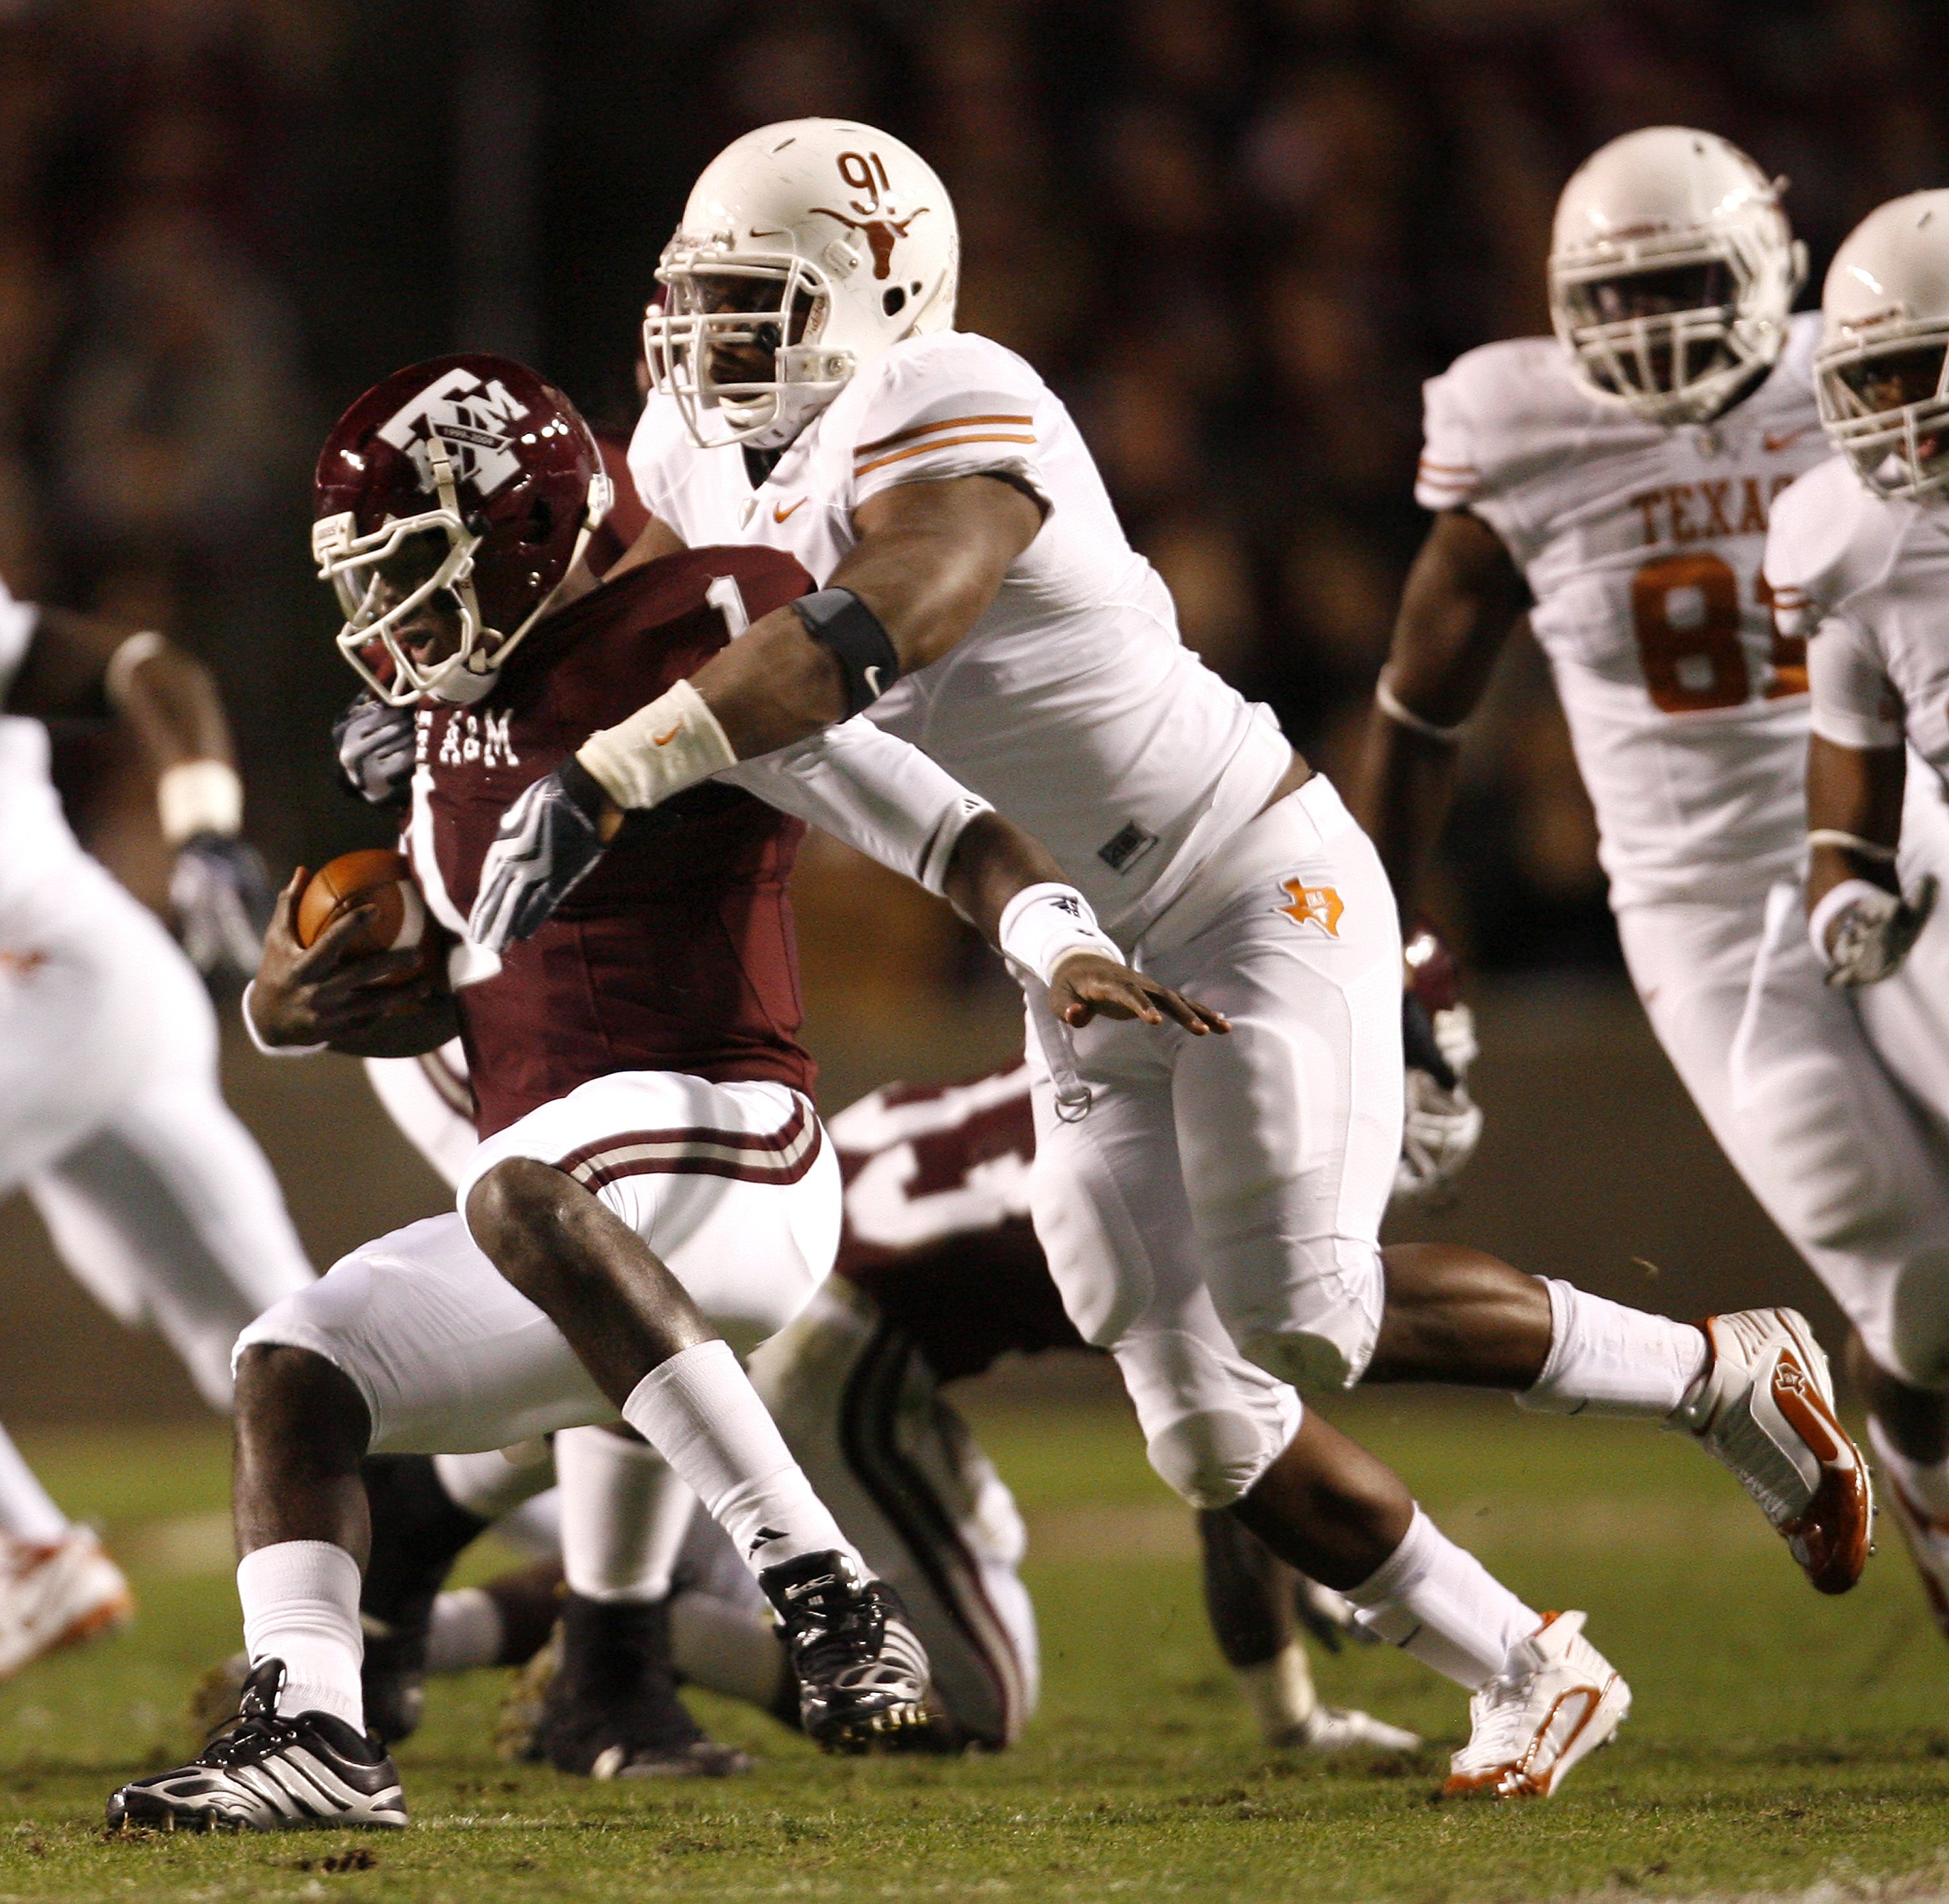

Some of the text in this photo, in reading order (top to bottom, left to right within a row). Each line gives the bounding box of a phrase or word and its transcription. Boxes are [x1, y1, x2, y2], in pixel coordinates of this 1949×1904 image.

[837, 151, 895, 215] 91
[1629, 474, 1794, 546] TEXA
[705, 574, 750, 643] 1
